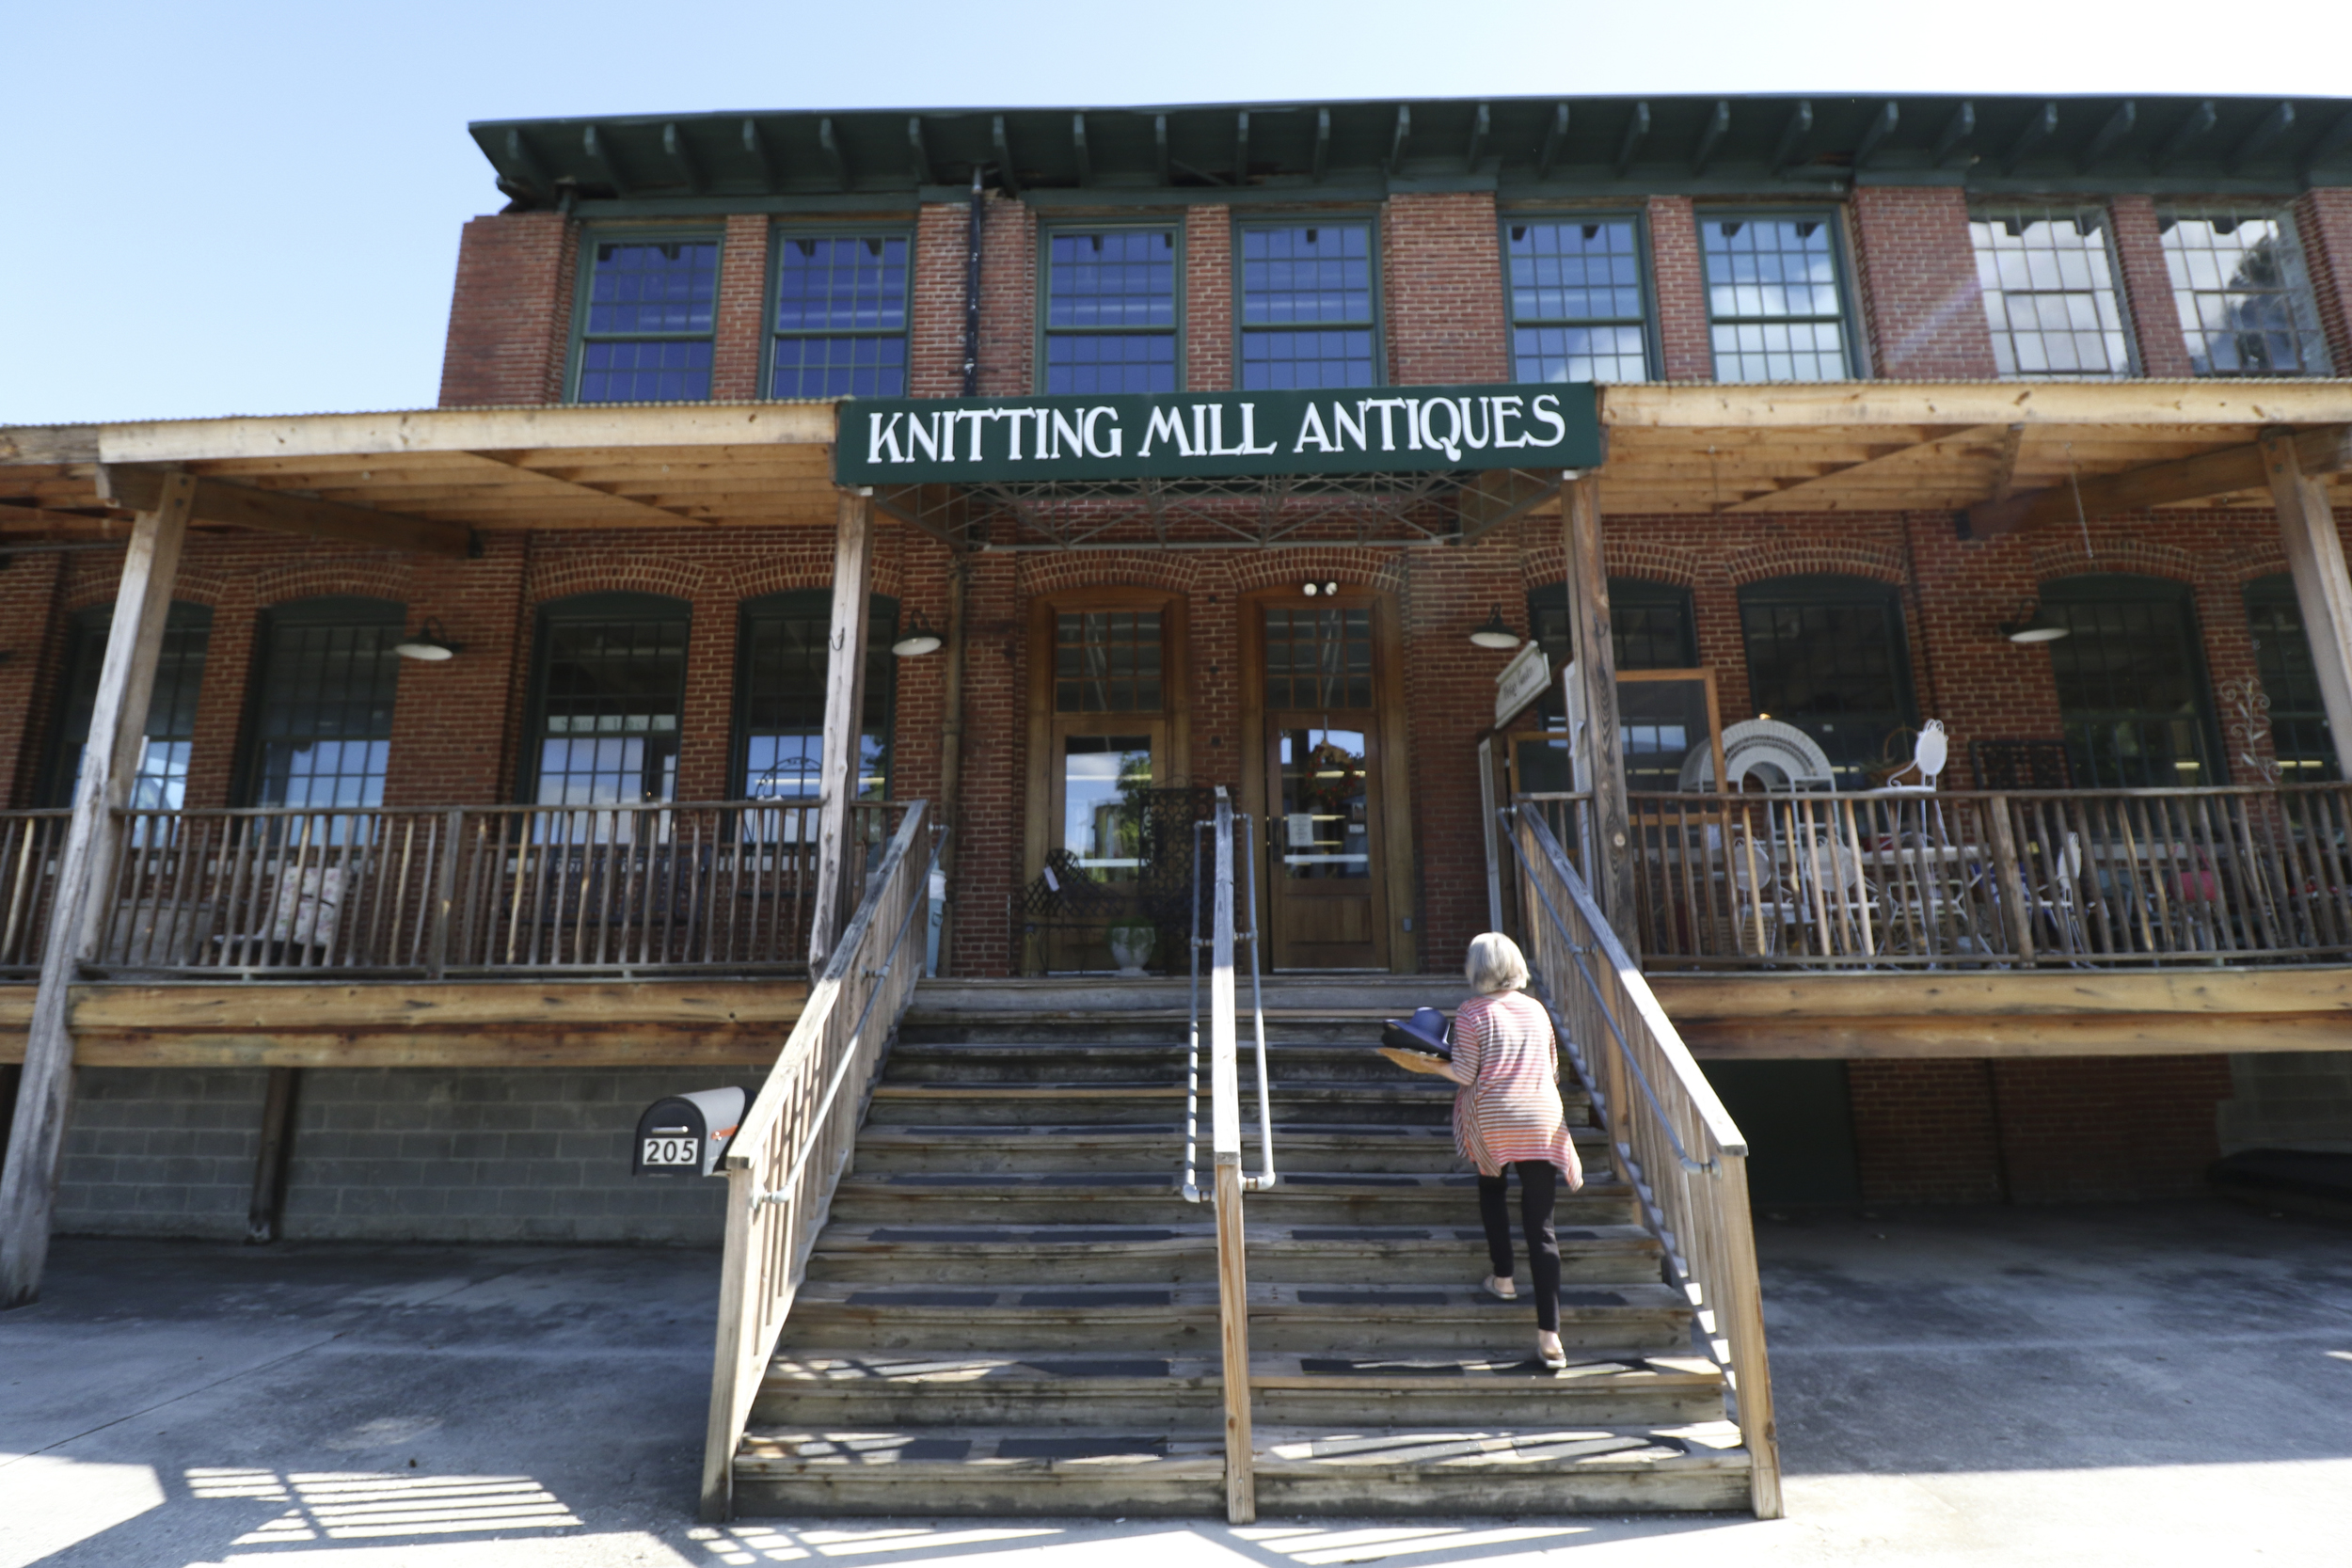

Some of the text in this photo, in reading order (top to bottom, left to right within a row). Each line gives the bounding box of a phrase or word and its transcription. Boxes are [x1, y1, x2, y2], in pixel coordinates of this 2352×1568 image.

[866, 394, 1565, 464] KNITTING MILL ANTIQUES
[646, 1140, 694, 1163] 205
